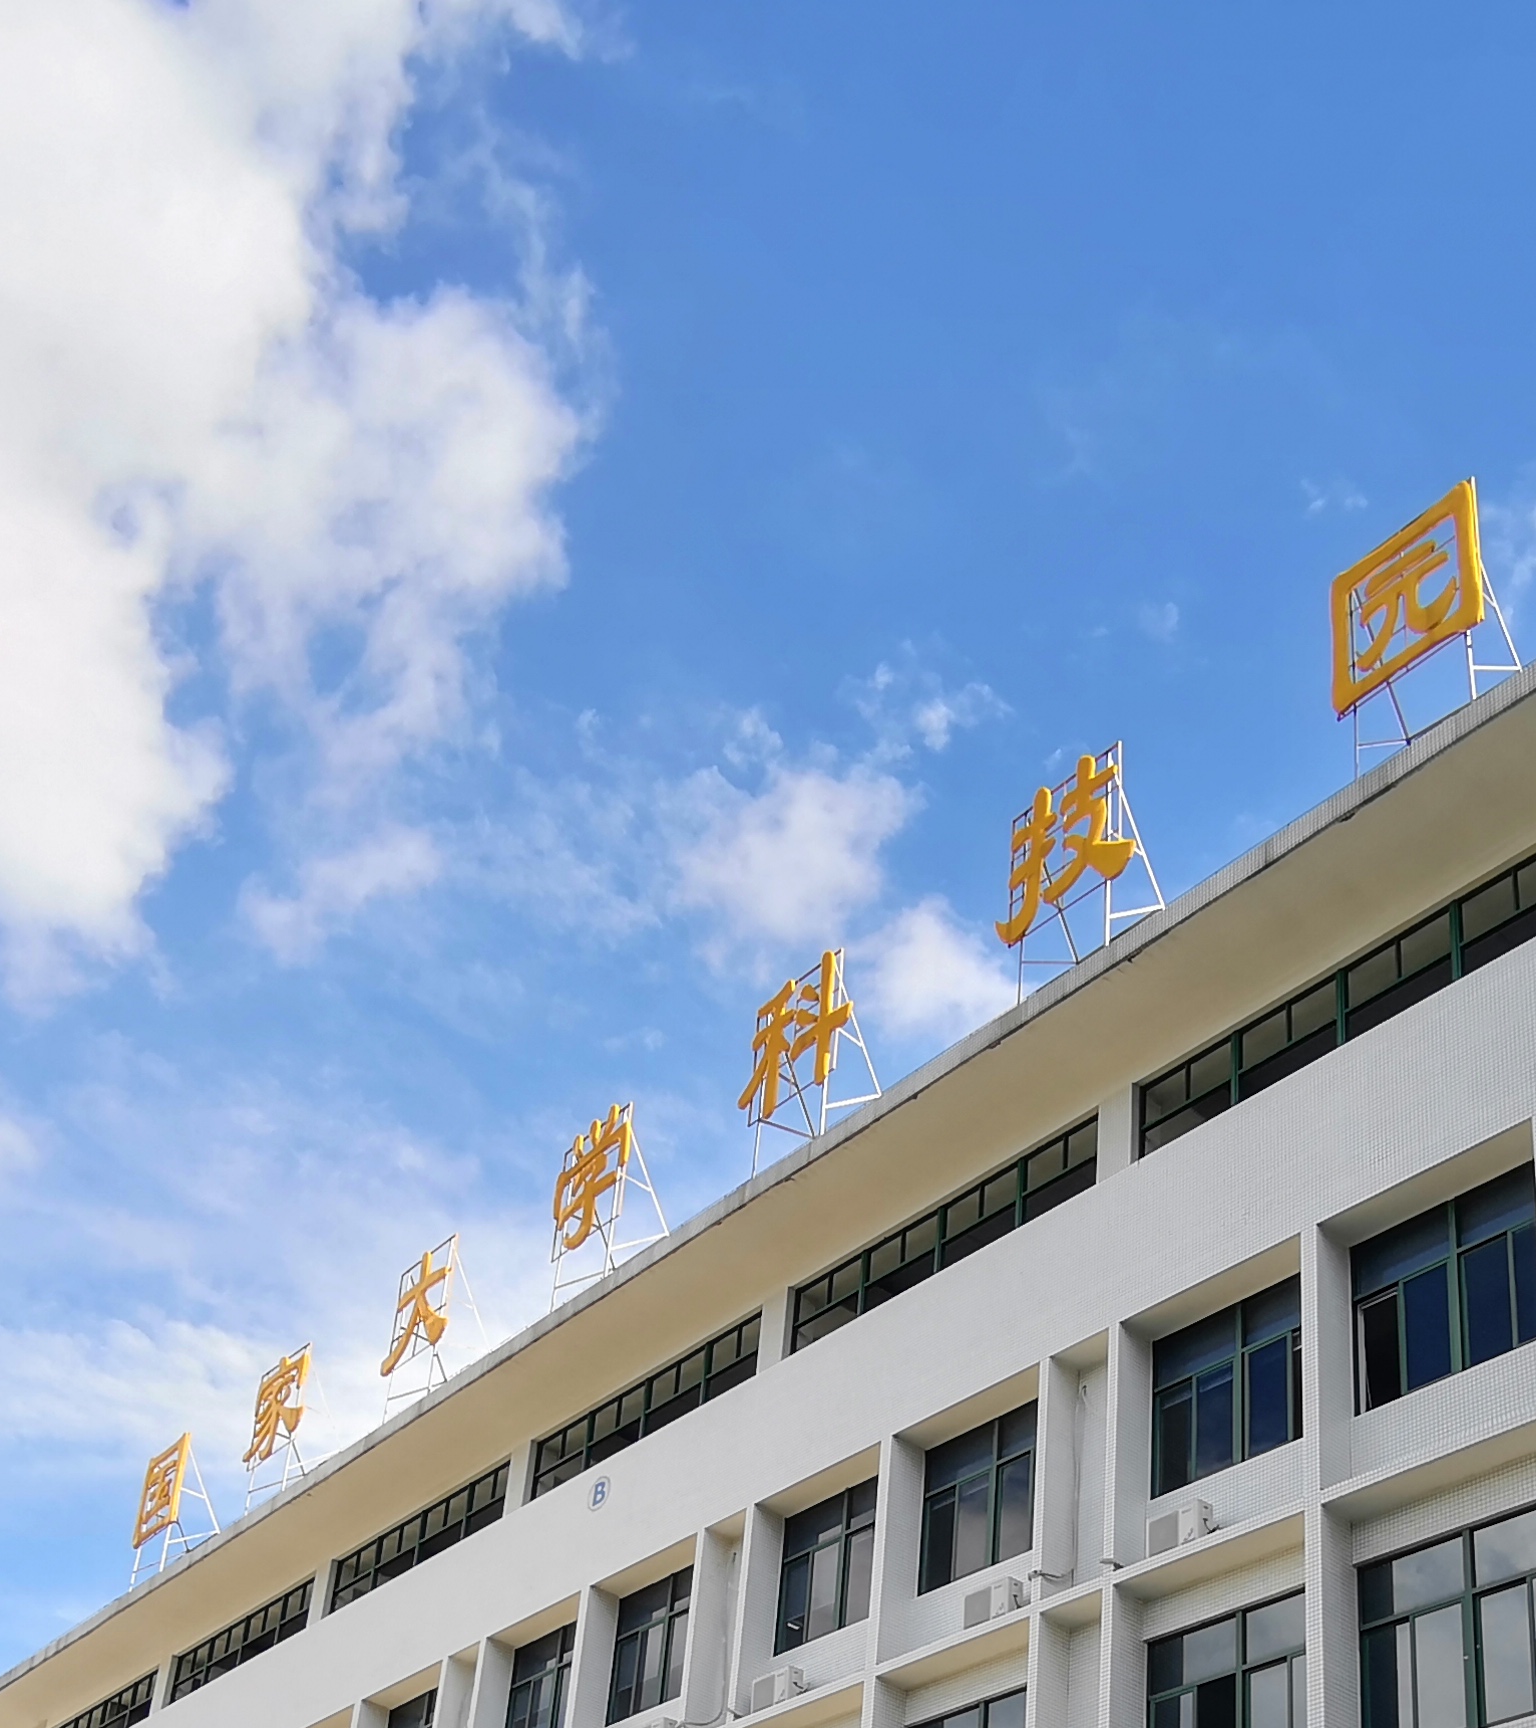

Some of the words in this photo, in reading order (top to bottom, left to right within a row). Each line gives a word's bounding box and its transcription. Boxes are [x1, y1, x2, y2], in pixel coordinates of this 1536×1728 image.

[132, 480, 1485, 1548] 国家大学科技园
[591, 1480, 606, 1507] B
